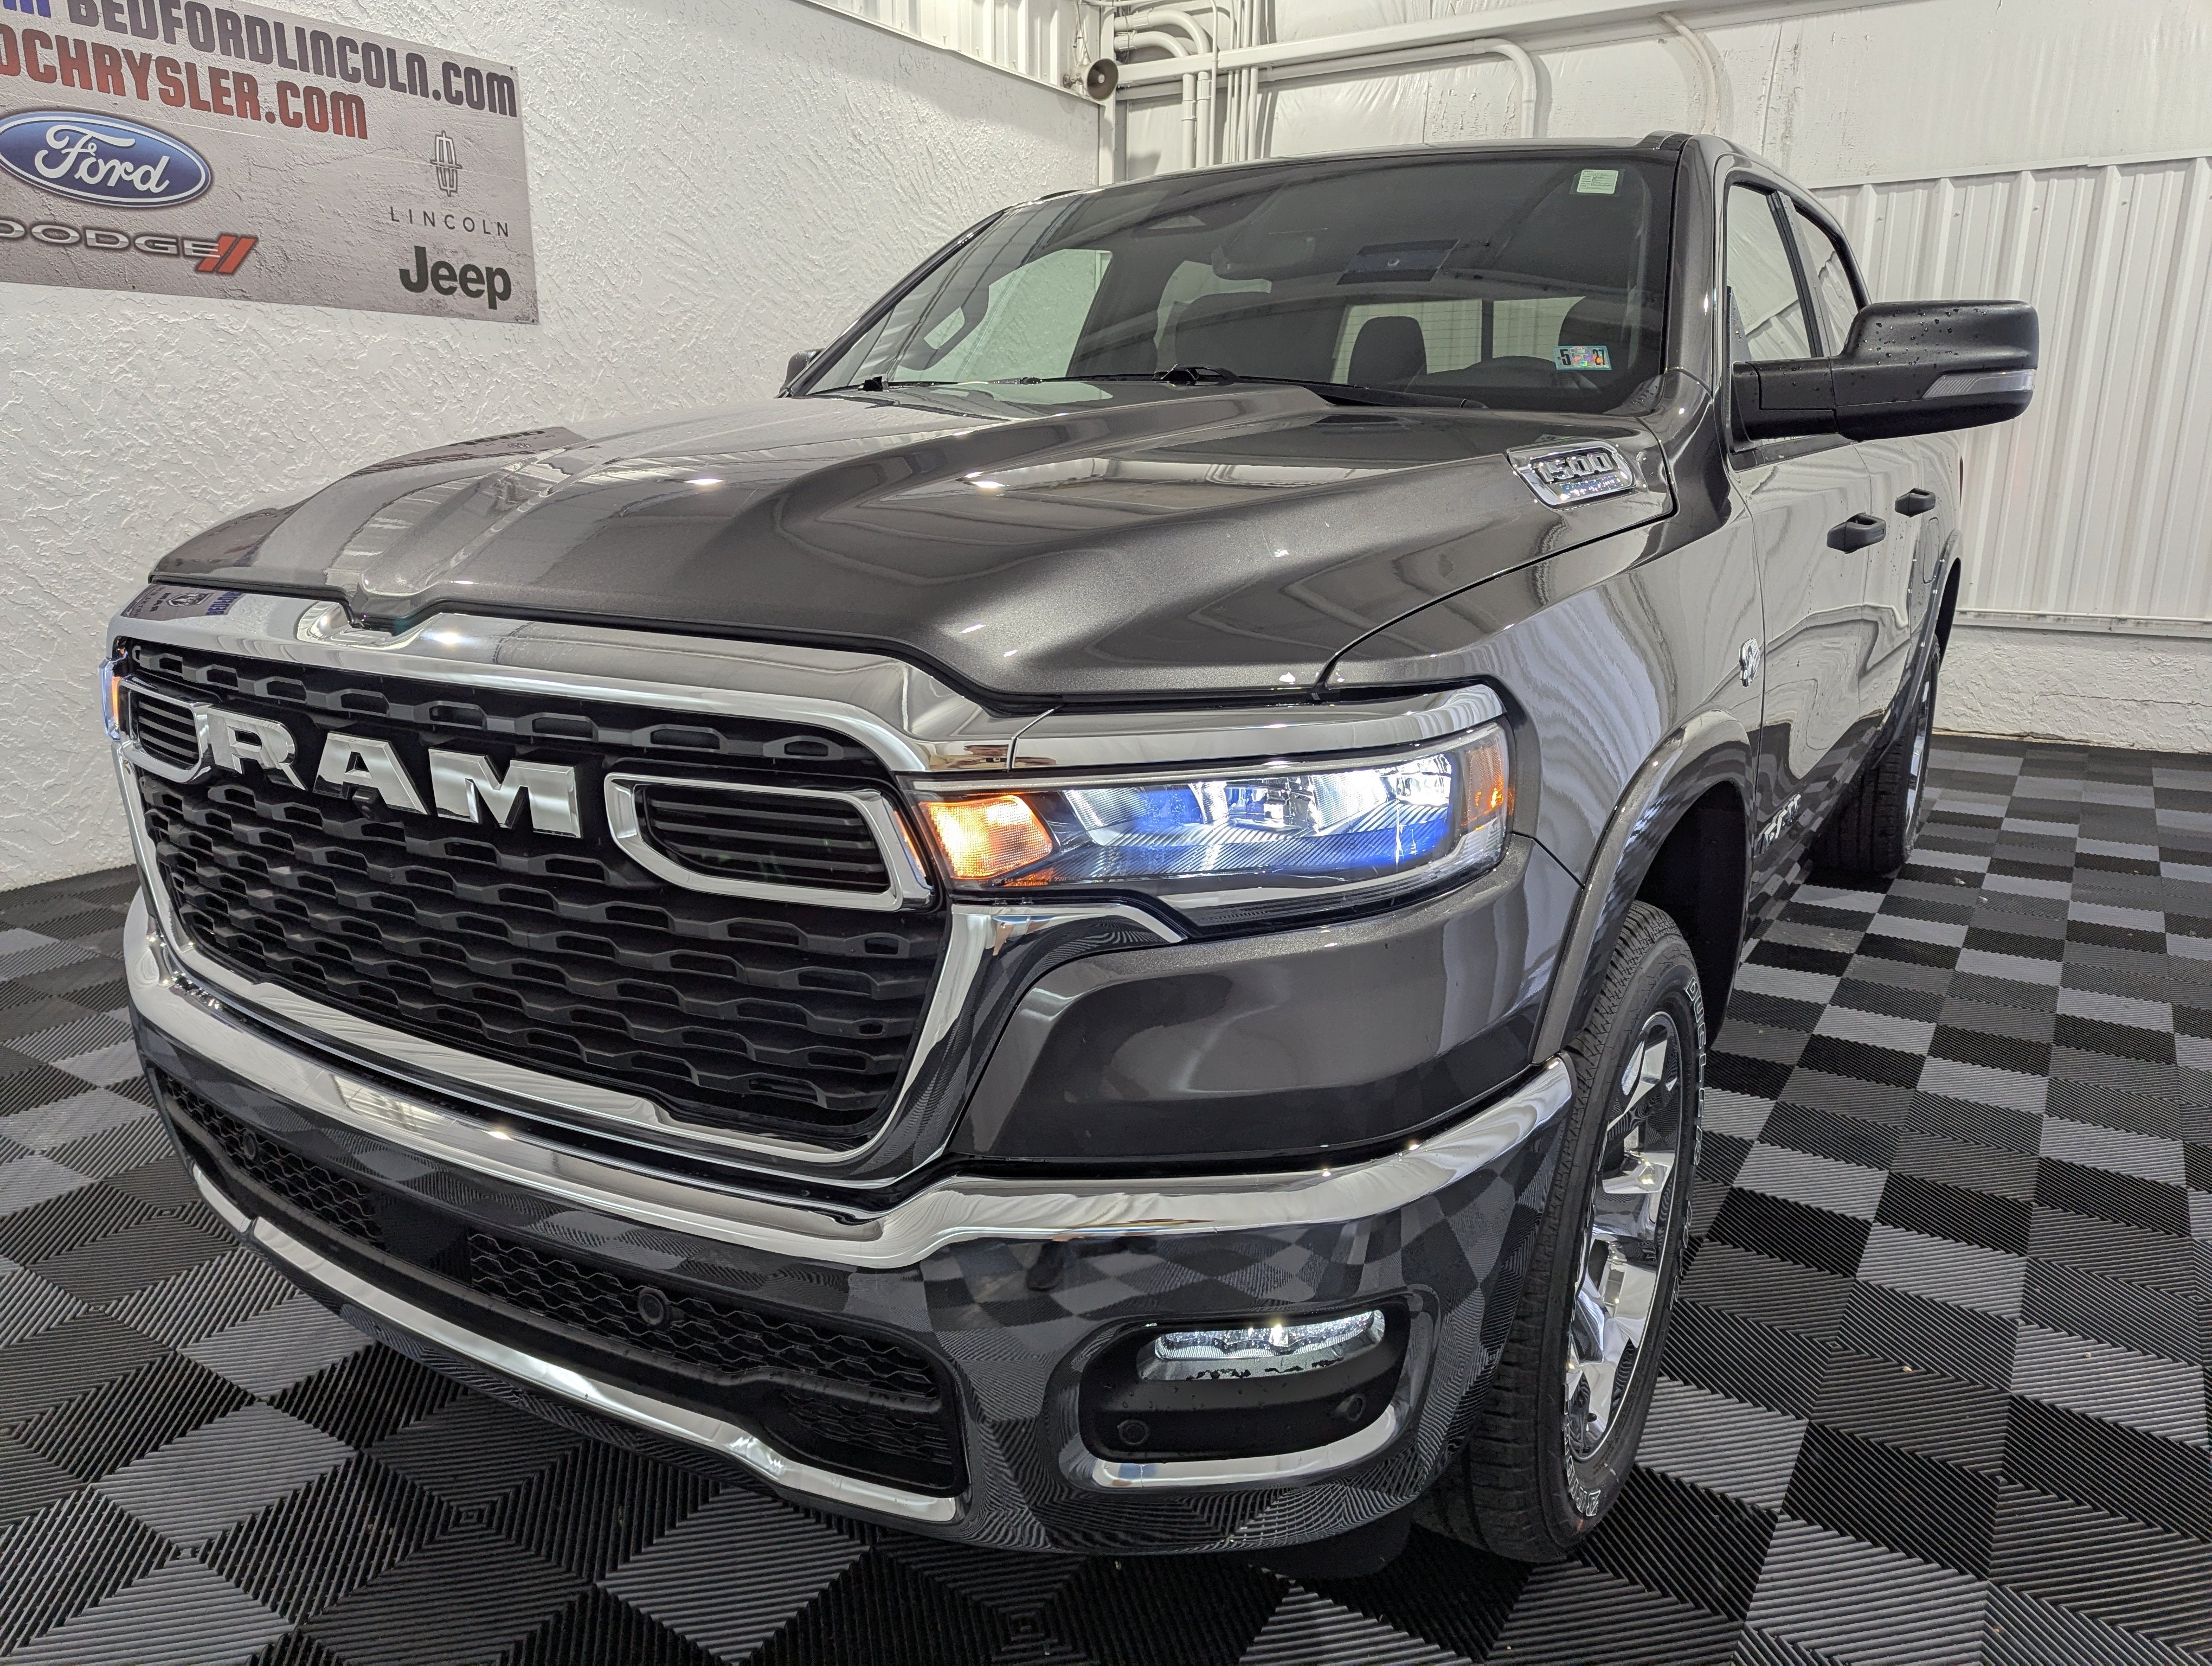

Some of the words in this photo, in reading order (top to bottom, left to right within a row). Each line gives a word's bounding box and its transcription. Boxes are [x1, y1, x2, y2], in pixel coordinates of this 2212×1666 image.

[35, 125, 170, 193] Ford
[390, 207, 508, 237] LINCOLN
[399, 246, 511, 310] Jeep
[1560, 349, 1571, 365] 5
[1533, 452, 1614, 483] 1500
[207, 706, 582, 838] RAM
[1684, 976, 1707, 1165] DUELER
